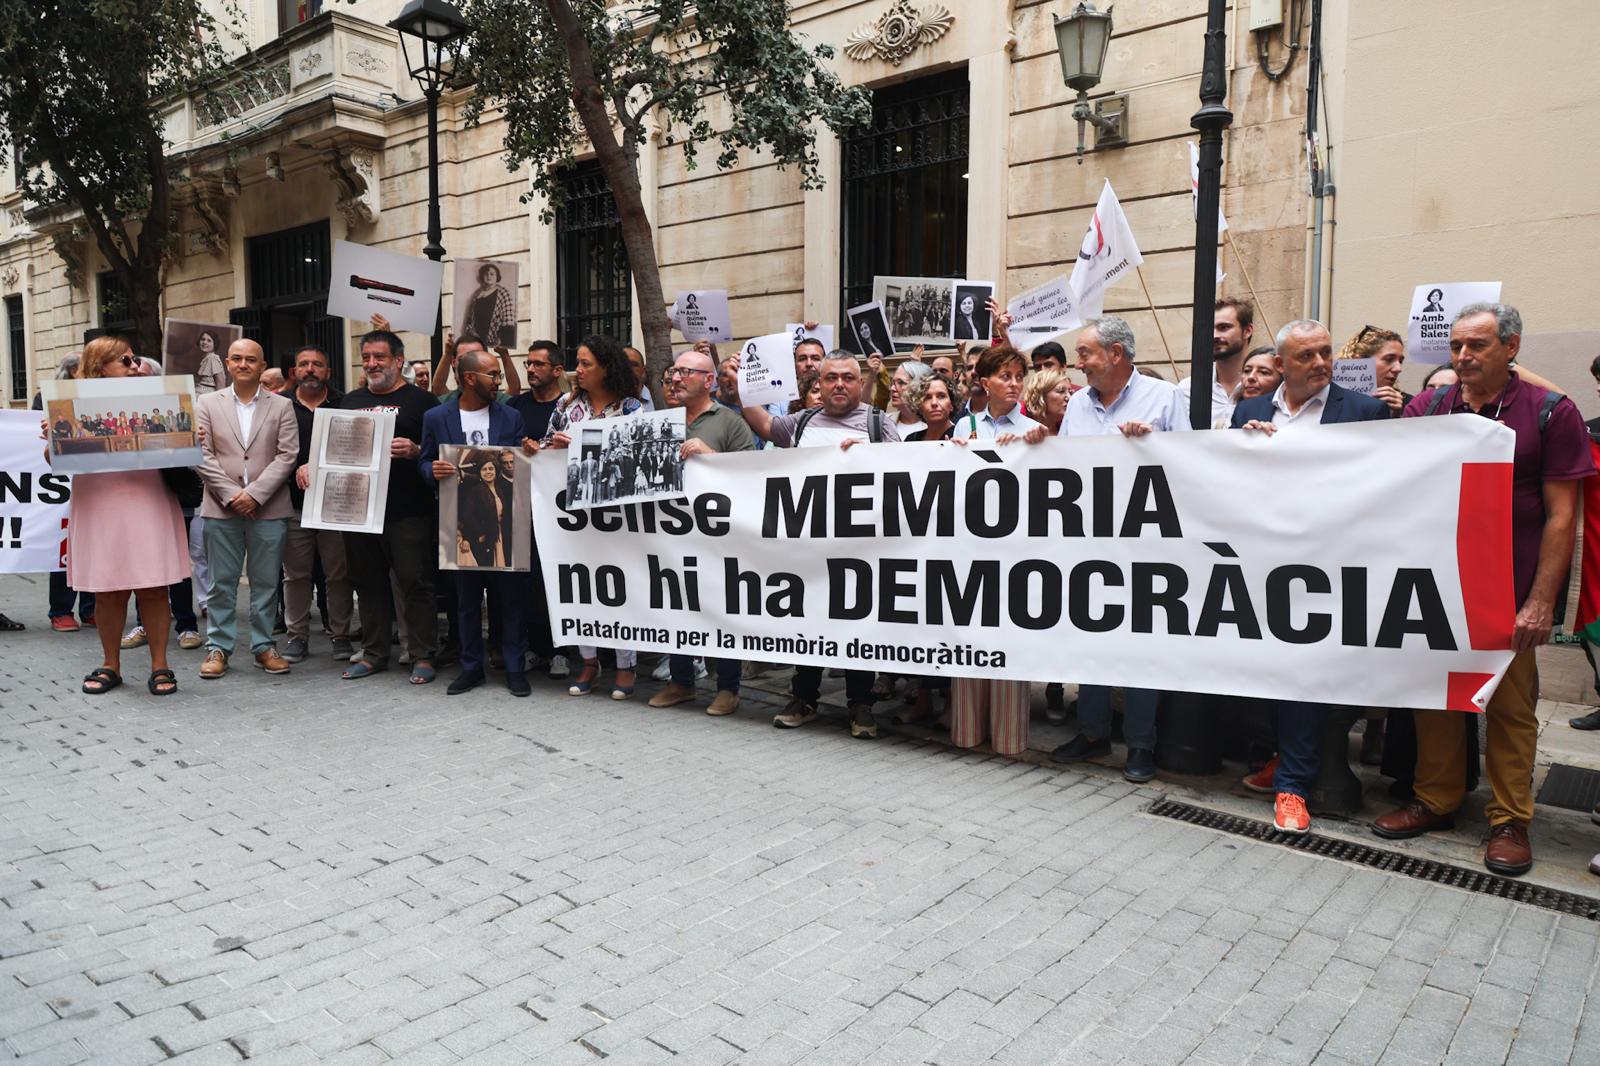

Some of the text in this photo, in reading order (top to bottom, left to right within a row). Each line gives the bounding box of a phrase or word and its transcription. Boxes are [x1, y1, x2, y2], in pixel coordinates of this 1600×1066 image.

[1421, 330, 1449, 338] bales
[555, 450, 1183, 539] sense MEMÒRIA
[558, 563, 626, 607] no
[647, 554, 701, 612] hi
[724, 557, 805, 617] ha
[826, 542, 1459, 651] DEMOCRÀCIA
[561, 618, 1006, 668] Plataforma per la memòria democràtica
